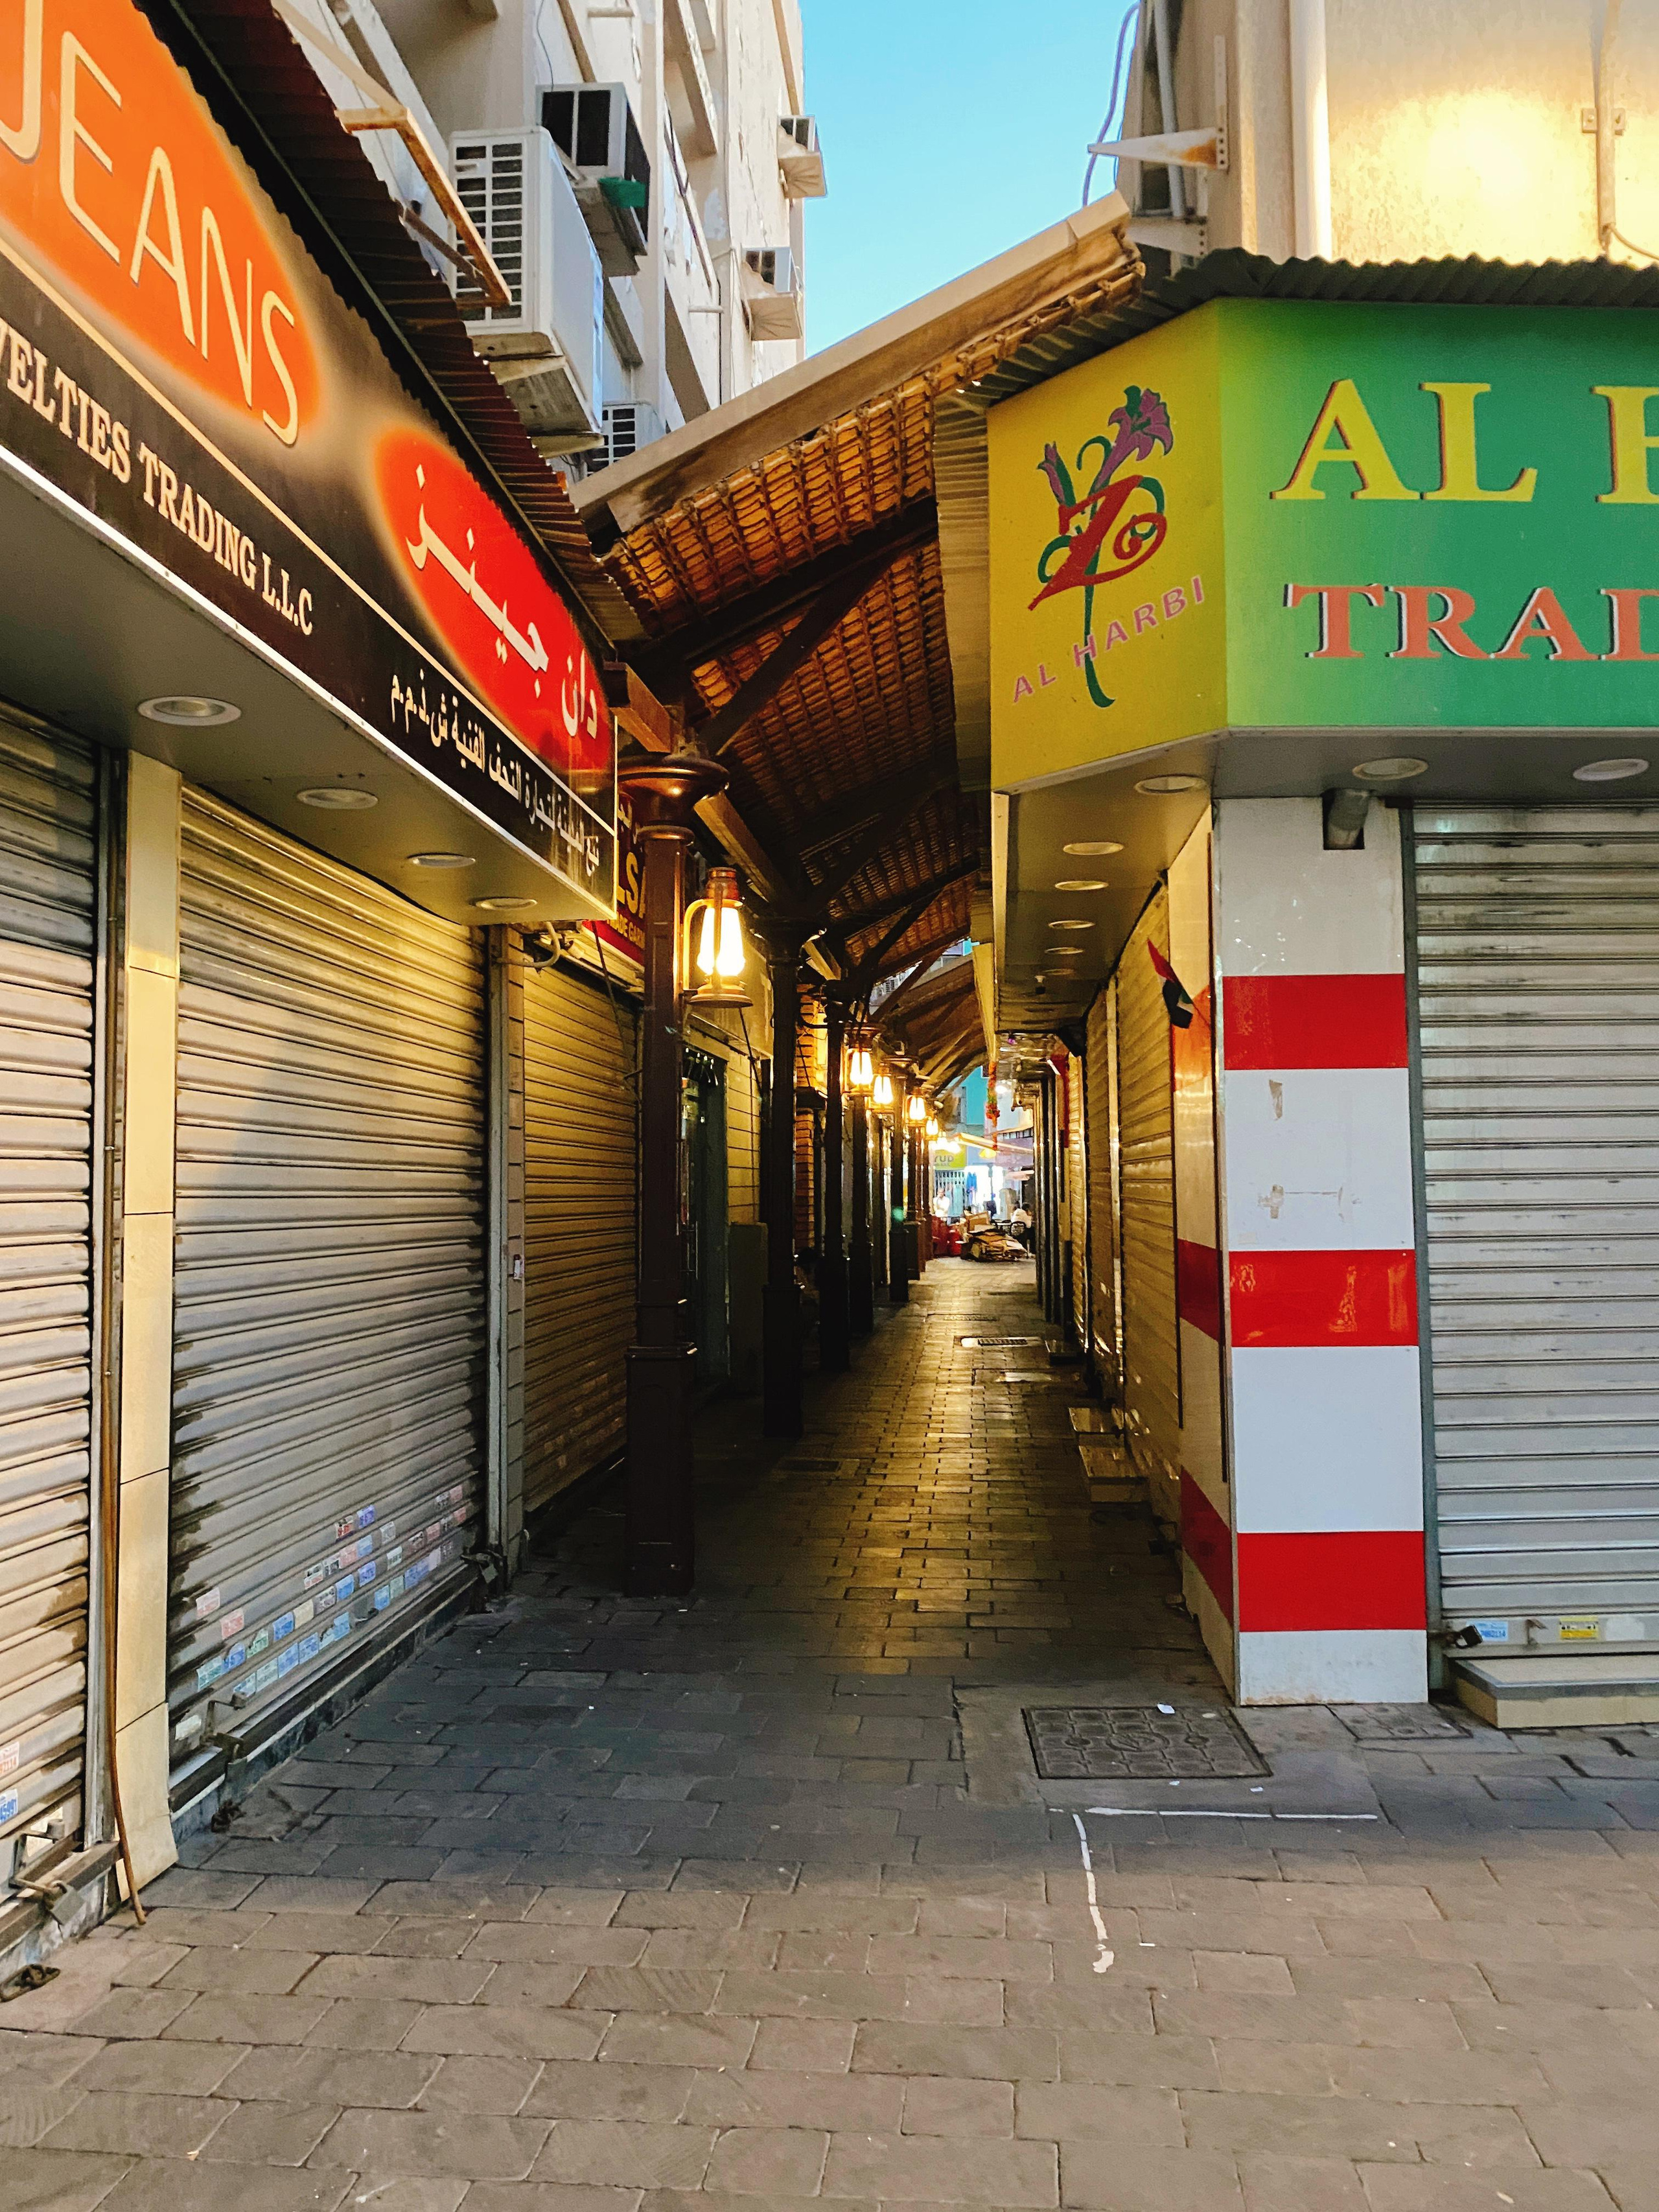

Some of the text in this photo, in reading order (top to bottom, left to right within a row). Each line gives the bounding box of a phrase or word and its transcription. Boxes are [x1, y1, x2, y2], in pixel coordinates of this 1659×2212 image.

[1270, 378, 1537, 501] AL
[137, 442, 257, 590] TRADING
[262, 552, 313, 635] L.L.C
[406, 463, 597, 739] دان جينز
[1013, 575, 1205, 704] AL HARBI
[452, 695, 485, 773] الفنية
[489, 742, 522, 804] التحف
